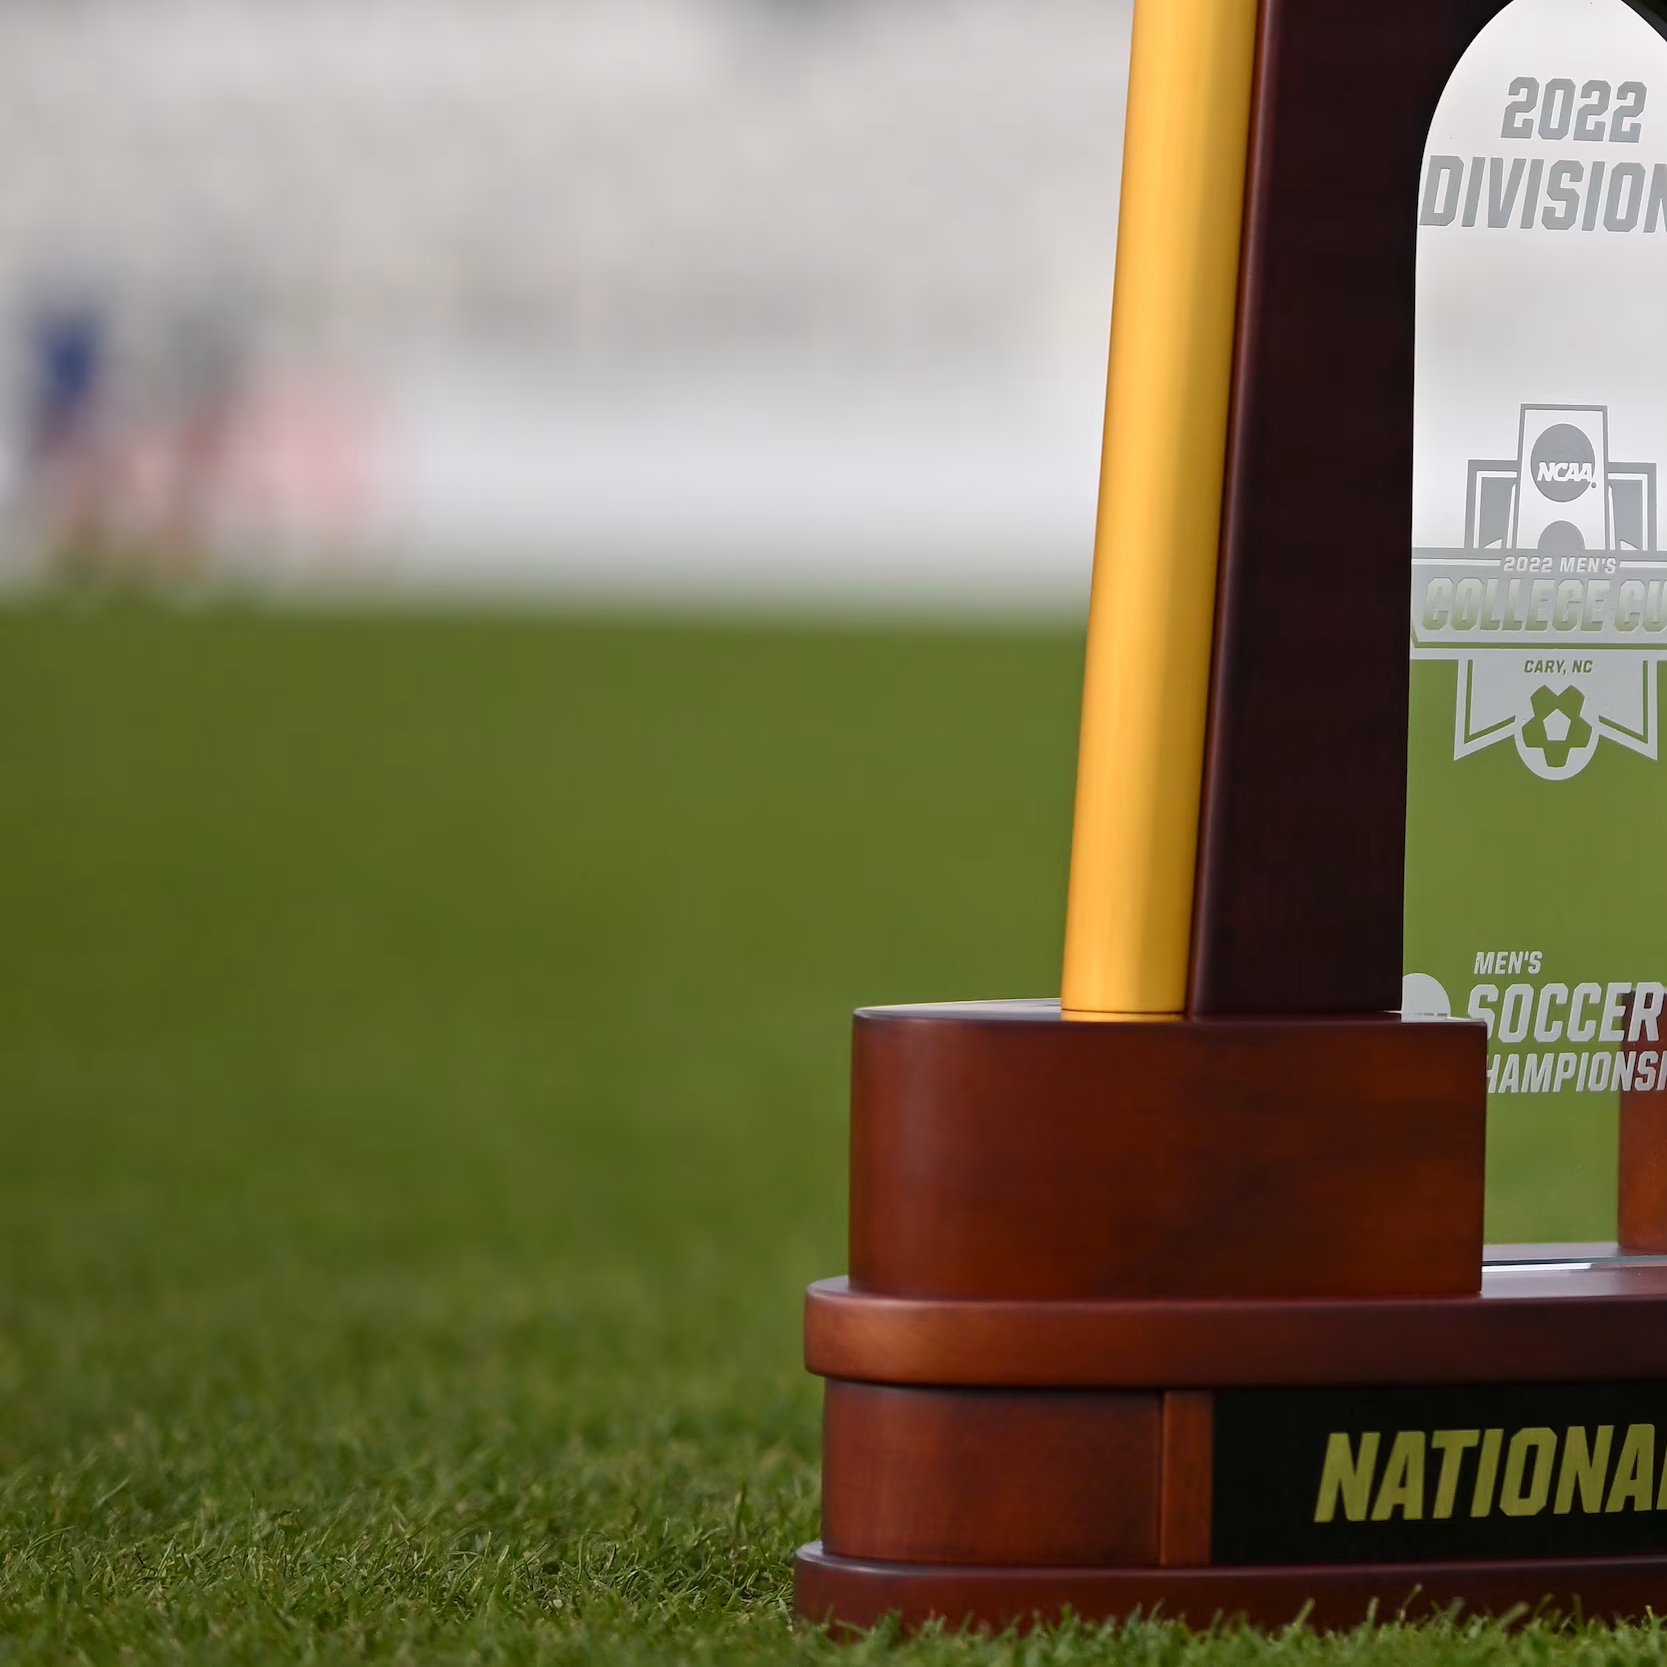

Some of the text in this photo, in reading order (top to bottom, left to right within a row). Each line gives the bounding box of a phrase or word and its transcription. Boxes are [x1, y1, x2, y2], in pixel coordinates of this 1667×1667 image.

[1501, 76, 1648, 144] 2022
[1536, 462, 1593, 482] NCAA
[1503, 556, 1617, 574] 2022 MEN'S
[1422, 577, 1611, 633] COLLEGE
[1523, 660, 1594, 675] CARY, NC
[1473, 950, 1543, 976] MEN'S
[1467, 981, 1665, 1044] SOCCER
